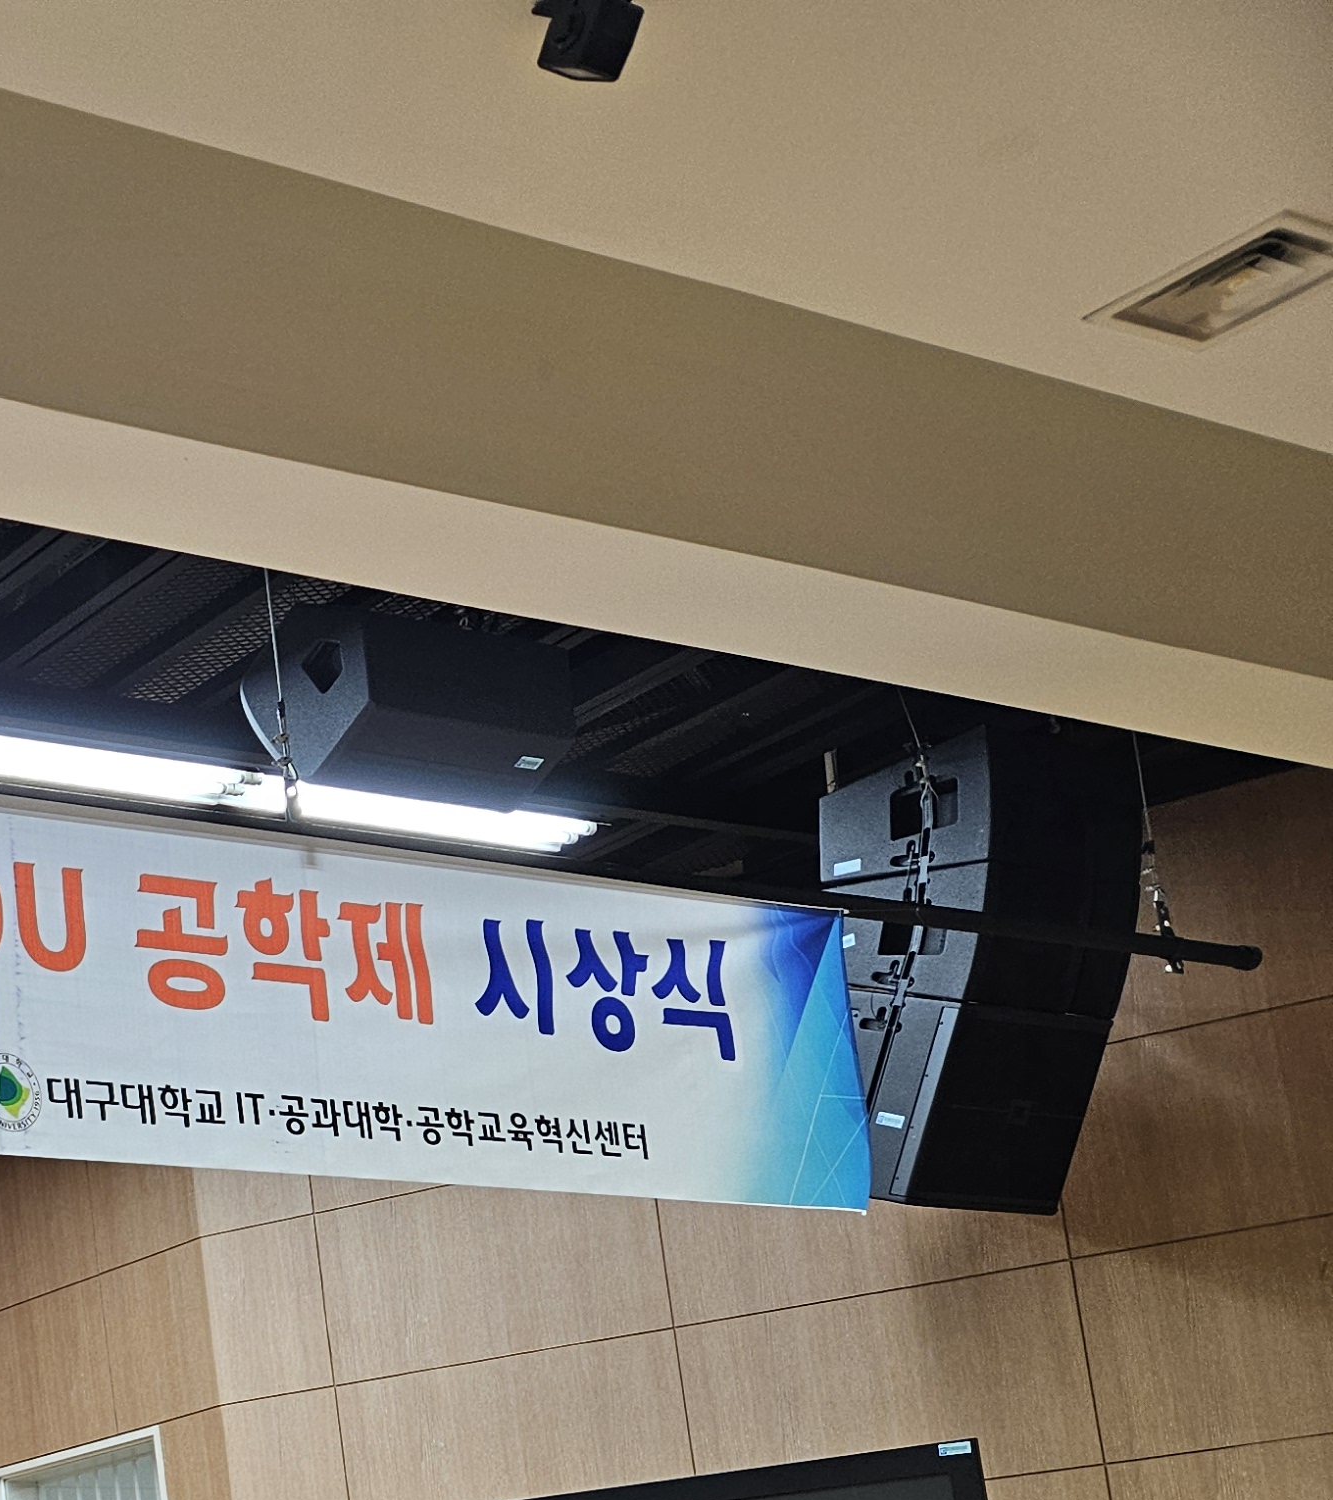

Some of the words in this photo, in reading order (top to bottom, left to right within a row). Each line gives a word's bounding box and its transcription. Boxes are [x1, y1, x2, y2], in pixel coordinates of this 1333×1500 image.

[137, 872, 433, 1023] 공학제
[476, 918, 735, 1060] 시상식
[46, 1077, 226, 1128] 대구대학교
